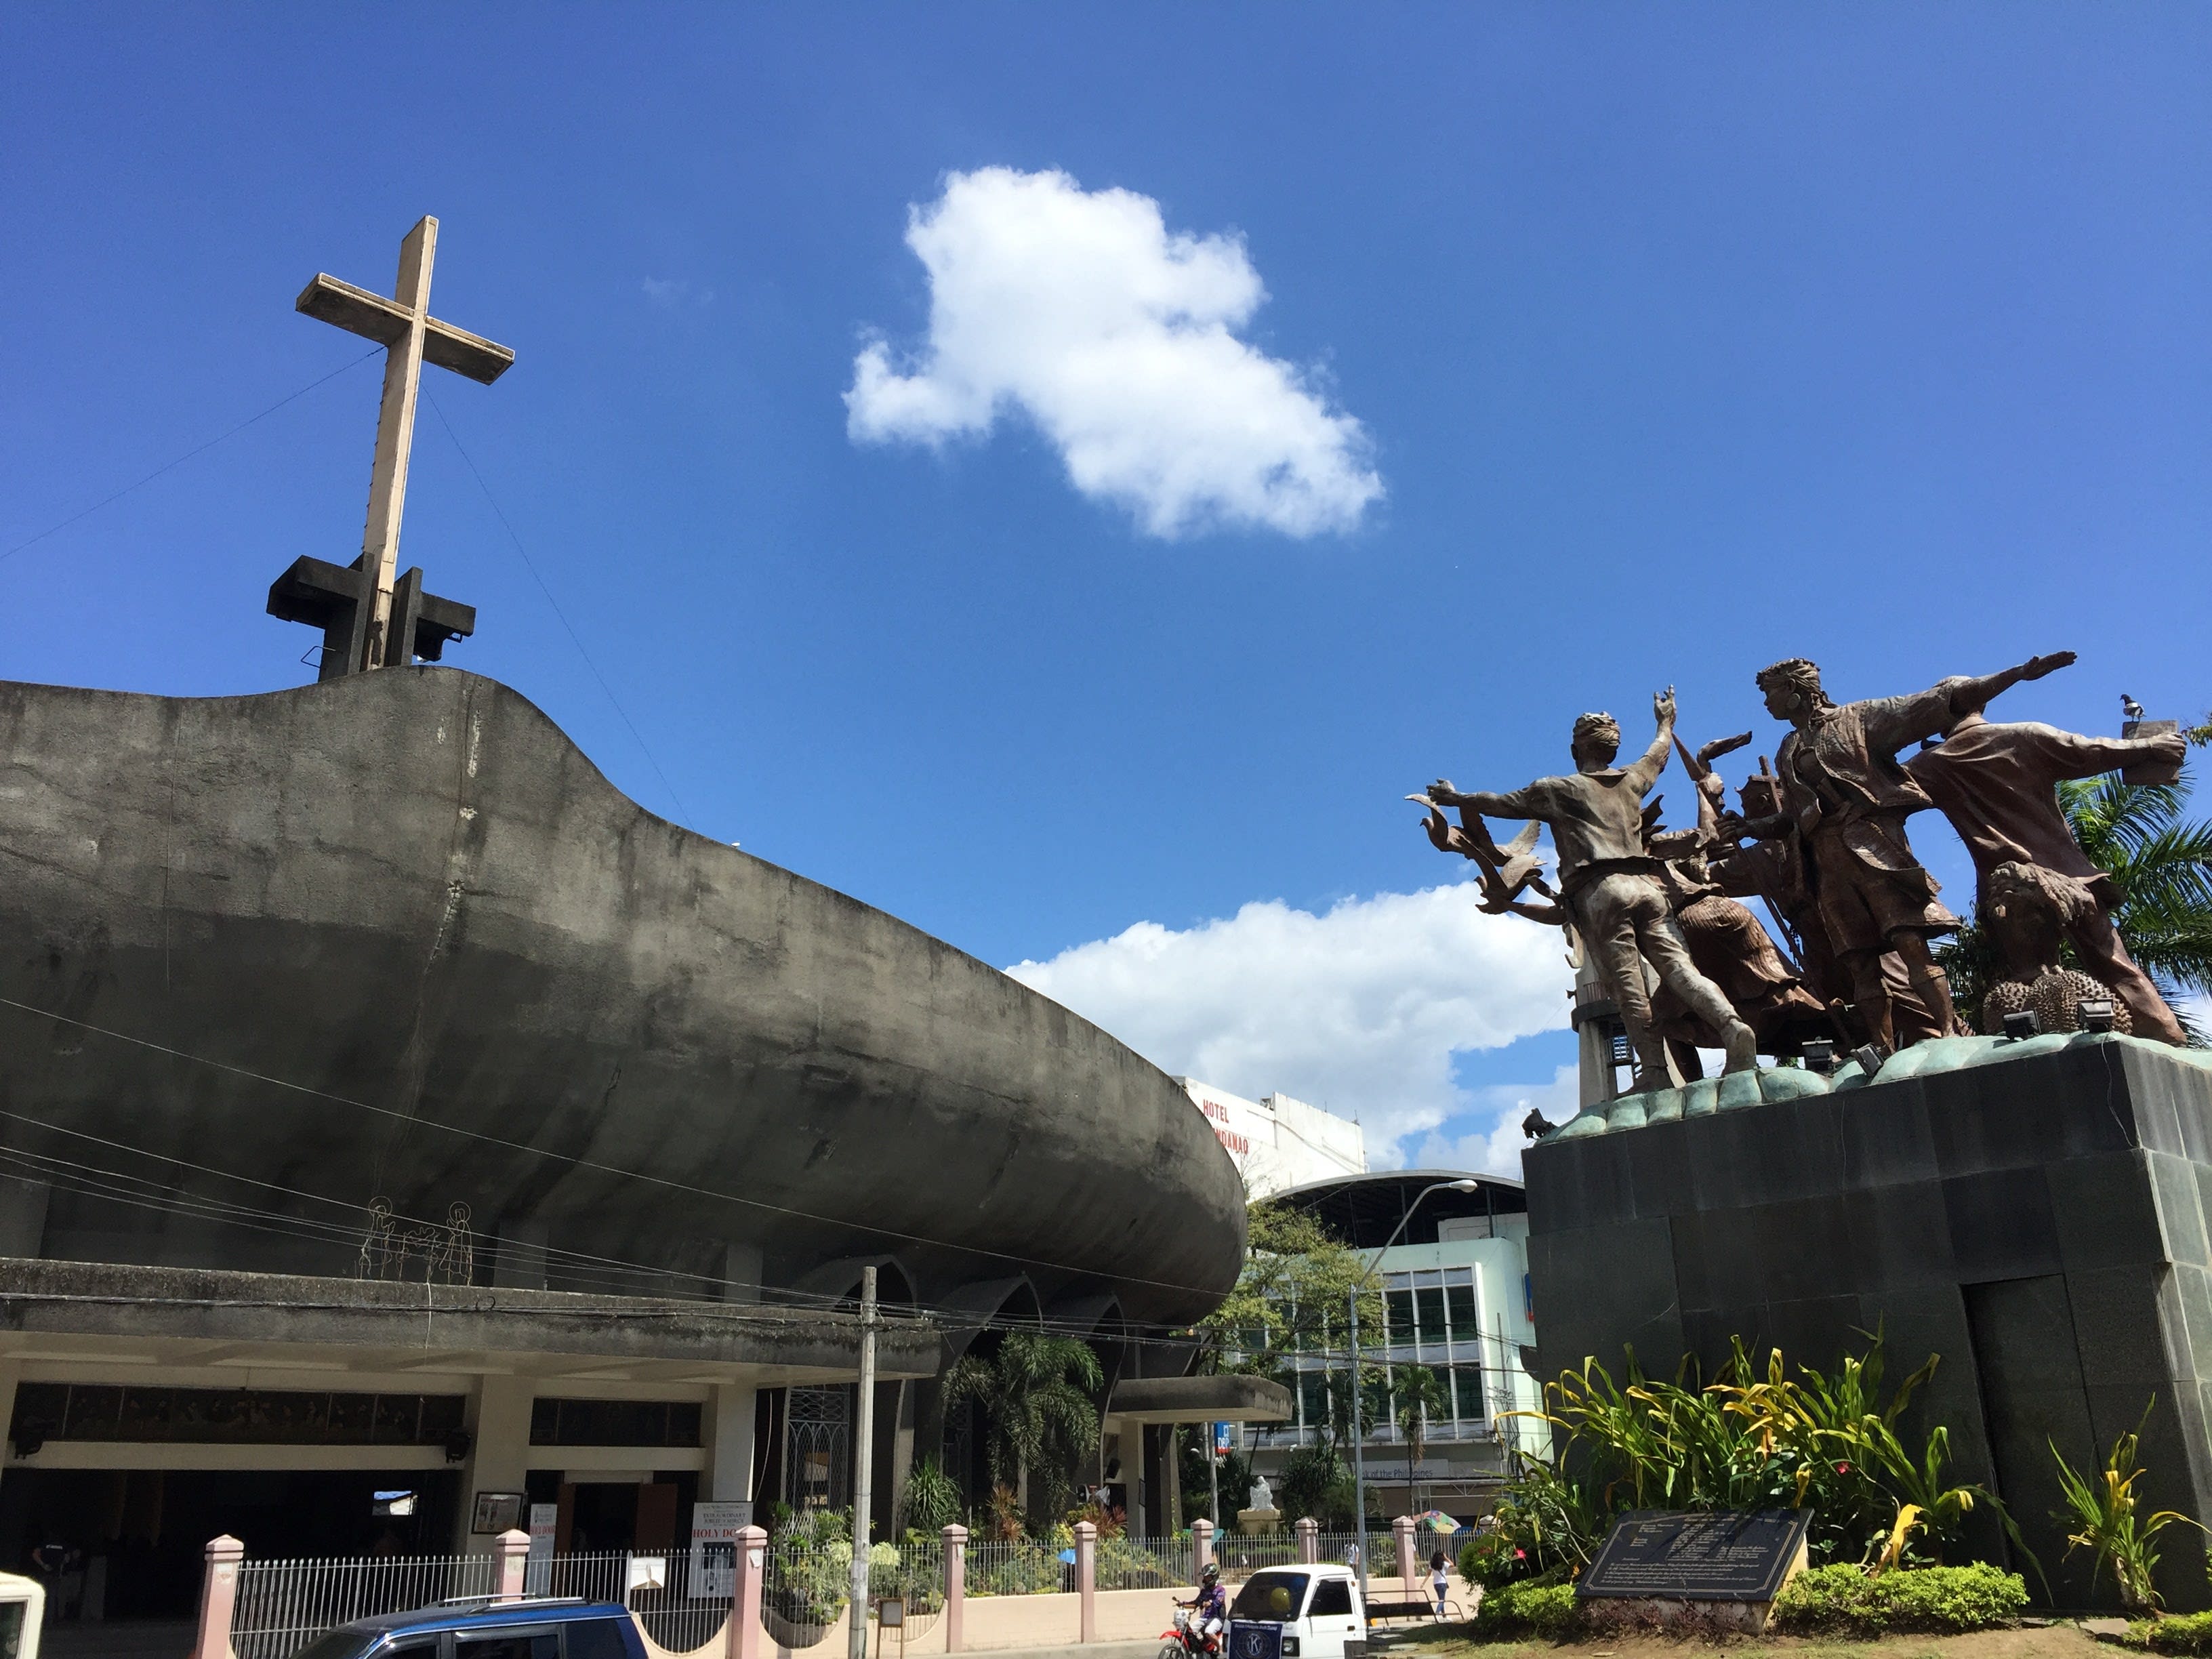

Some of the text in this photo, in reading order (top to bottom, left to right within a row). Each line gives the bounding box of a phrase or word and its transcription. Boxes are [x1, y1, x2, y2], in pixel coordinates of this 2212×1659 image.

[1204, 1099, 1229, 1124] HOTEL
[1218, 1437, 1229, 1450] DBP
[1371, 1469, 1378, 1477] of
[1380, 1469, 1392, 1477] the
[693, 1529, 718, 1538] HOLY
